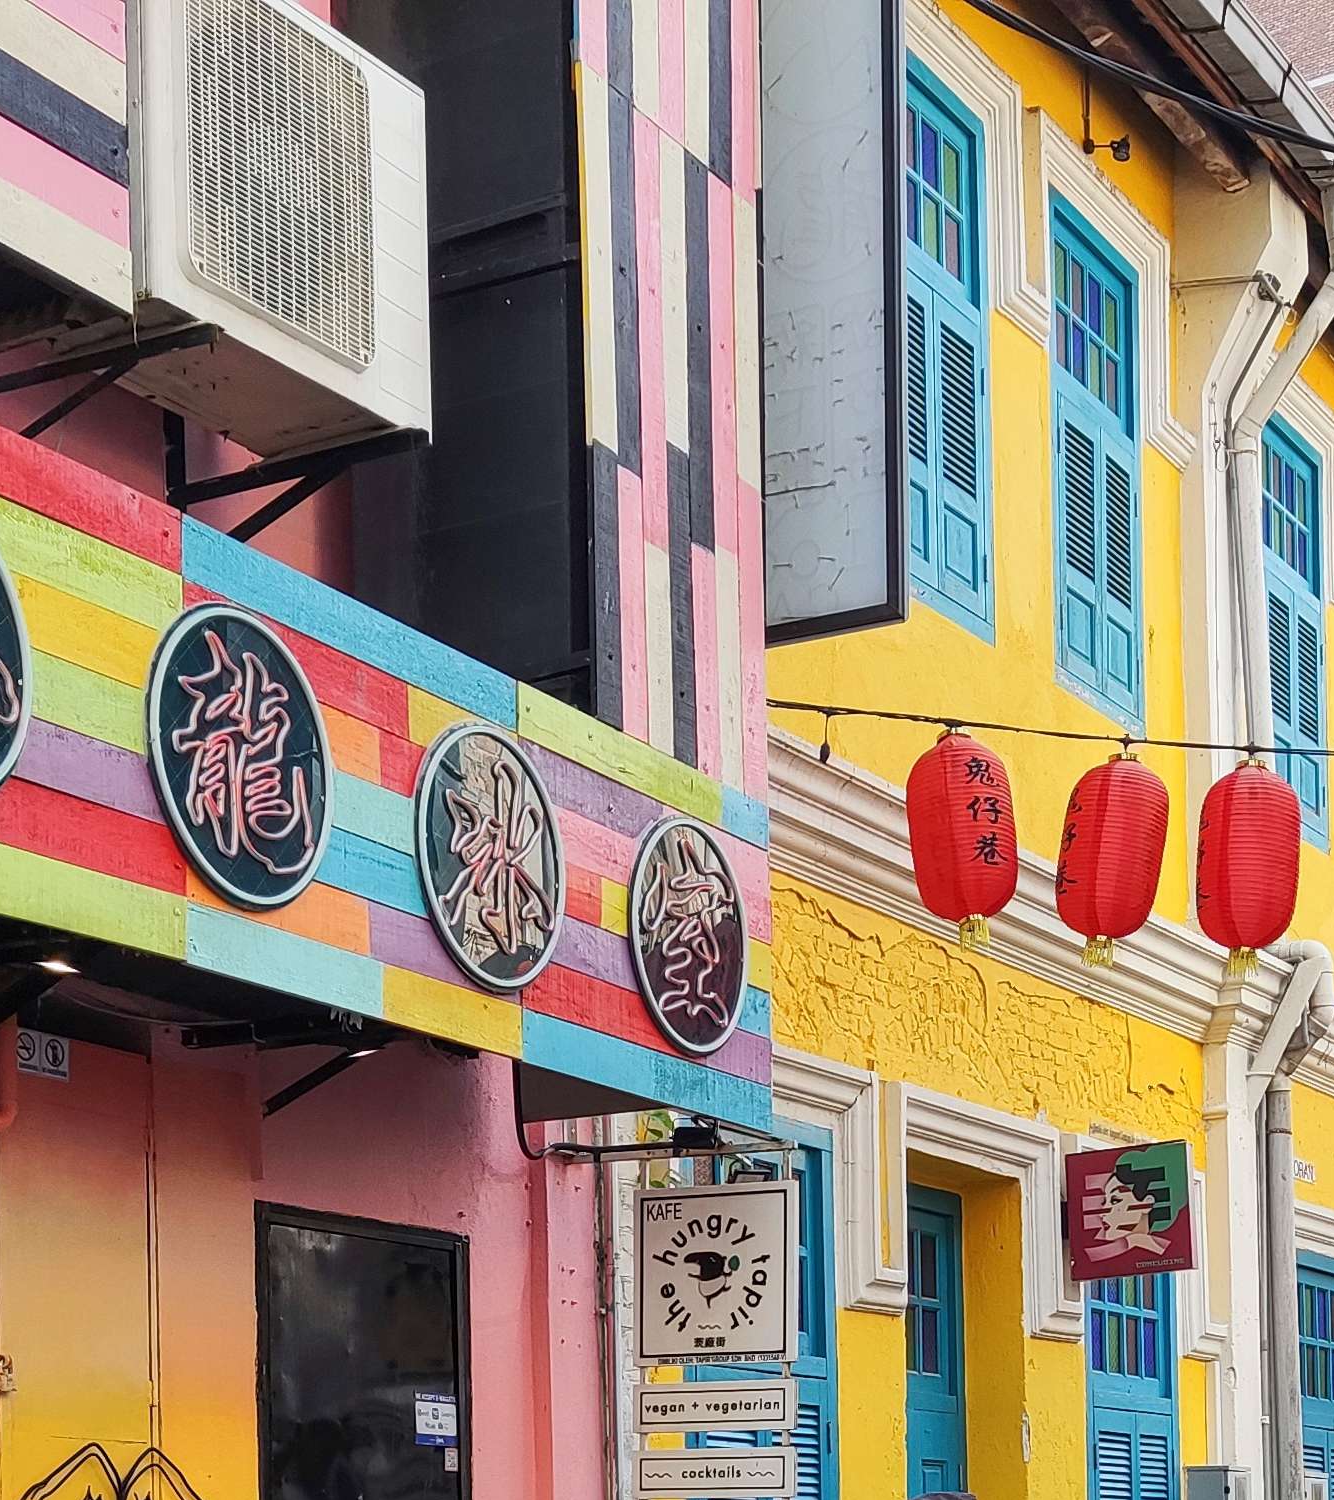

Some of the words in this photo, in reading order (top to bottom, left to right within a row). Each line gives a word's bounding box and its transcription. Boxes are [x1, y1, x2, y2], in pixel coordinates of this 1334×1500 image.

[964, 756, 1009, 866] 鬼仔巷
[646, 1202, 683, 1222] KAFE
[652, 1214, 756, 1267] hungry
[660, 1282, 692, 1333] the
[730, 1254, 771, 1330] tapir
[645, 1404, 685, 1416] vegan
[706, 1398, 780, 1415] vegetarian
[681, 1465, 742, 1480] cocktails
